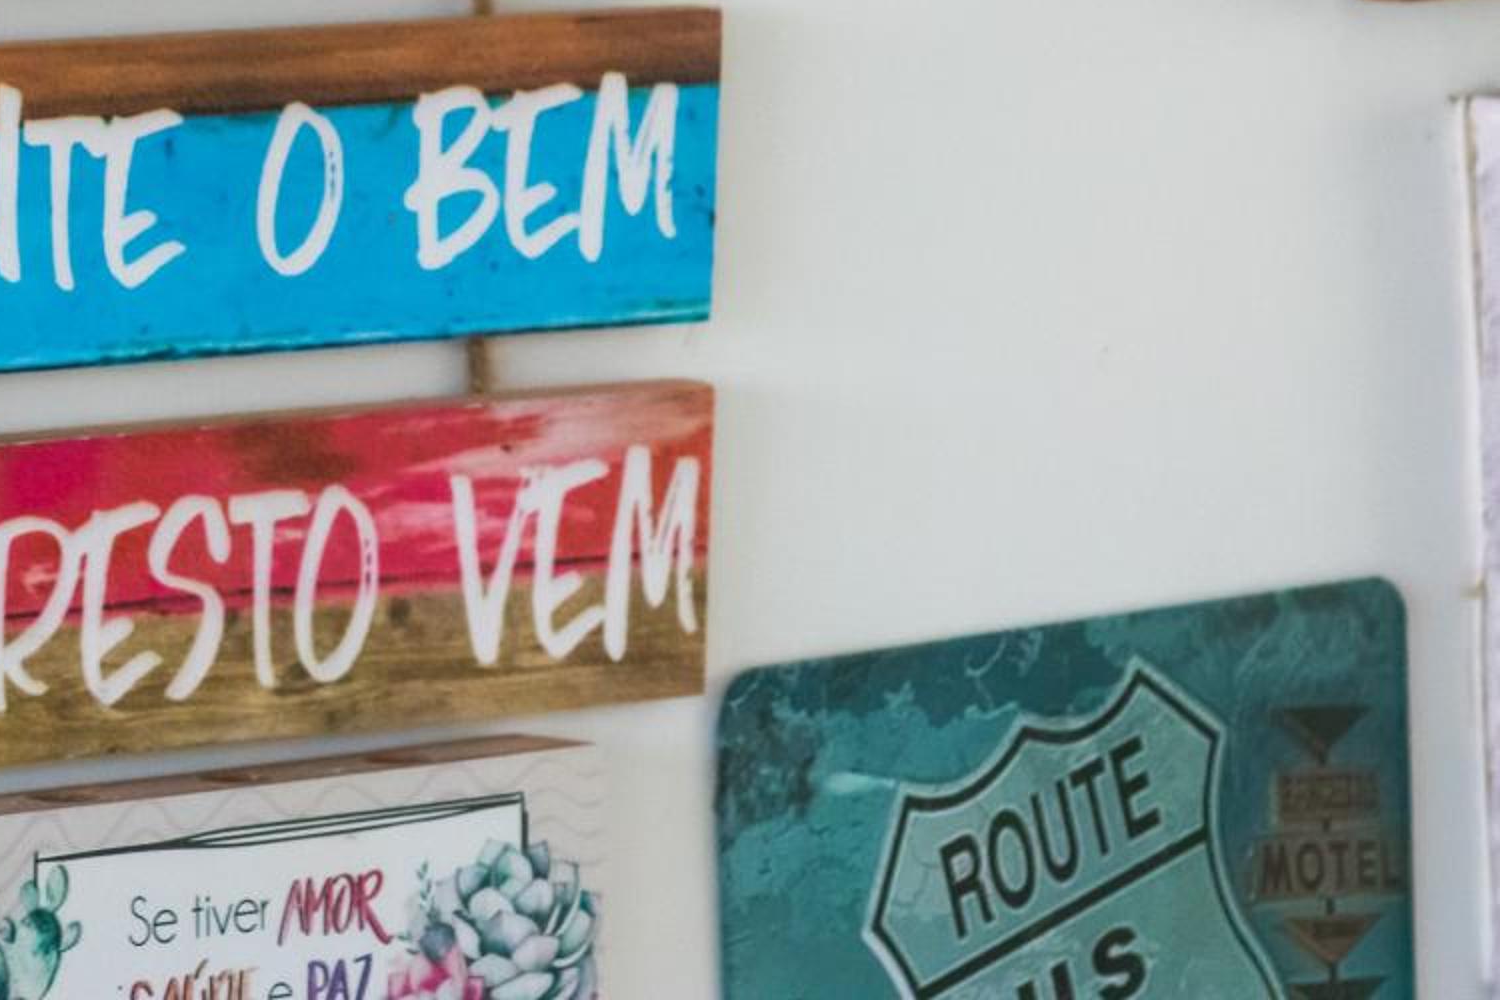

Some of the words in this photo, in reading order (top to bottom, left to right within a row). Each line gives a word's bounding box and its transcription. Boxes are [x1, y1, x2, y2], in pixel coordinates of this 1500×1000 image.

[258, 103, 343, 275] O
[406, 73, 680, 269] BEM
[451, 446, 698, 666] VEM
[128, 895, 178, 947] Se
[192, 894, 270, 939] tiver
[276, 868, 393, 947] AMOR
[939, 736, 1162, 940] ROUTE
[1260, 839, 1398, 894] MOTEL
